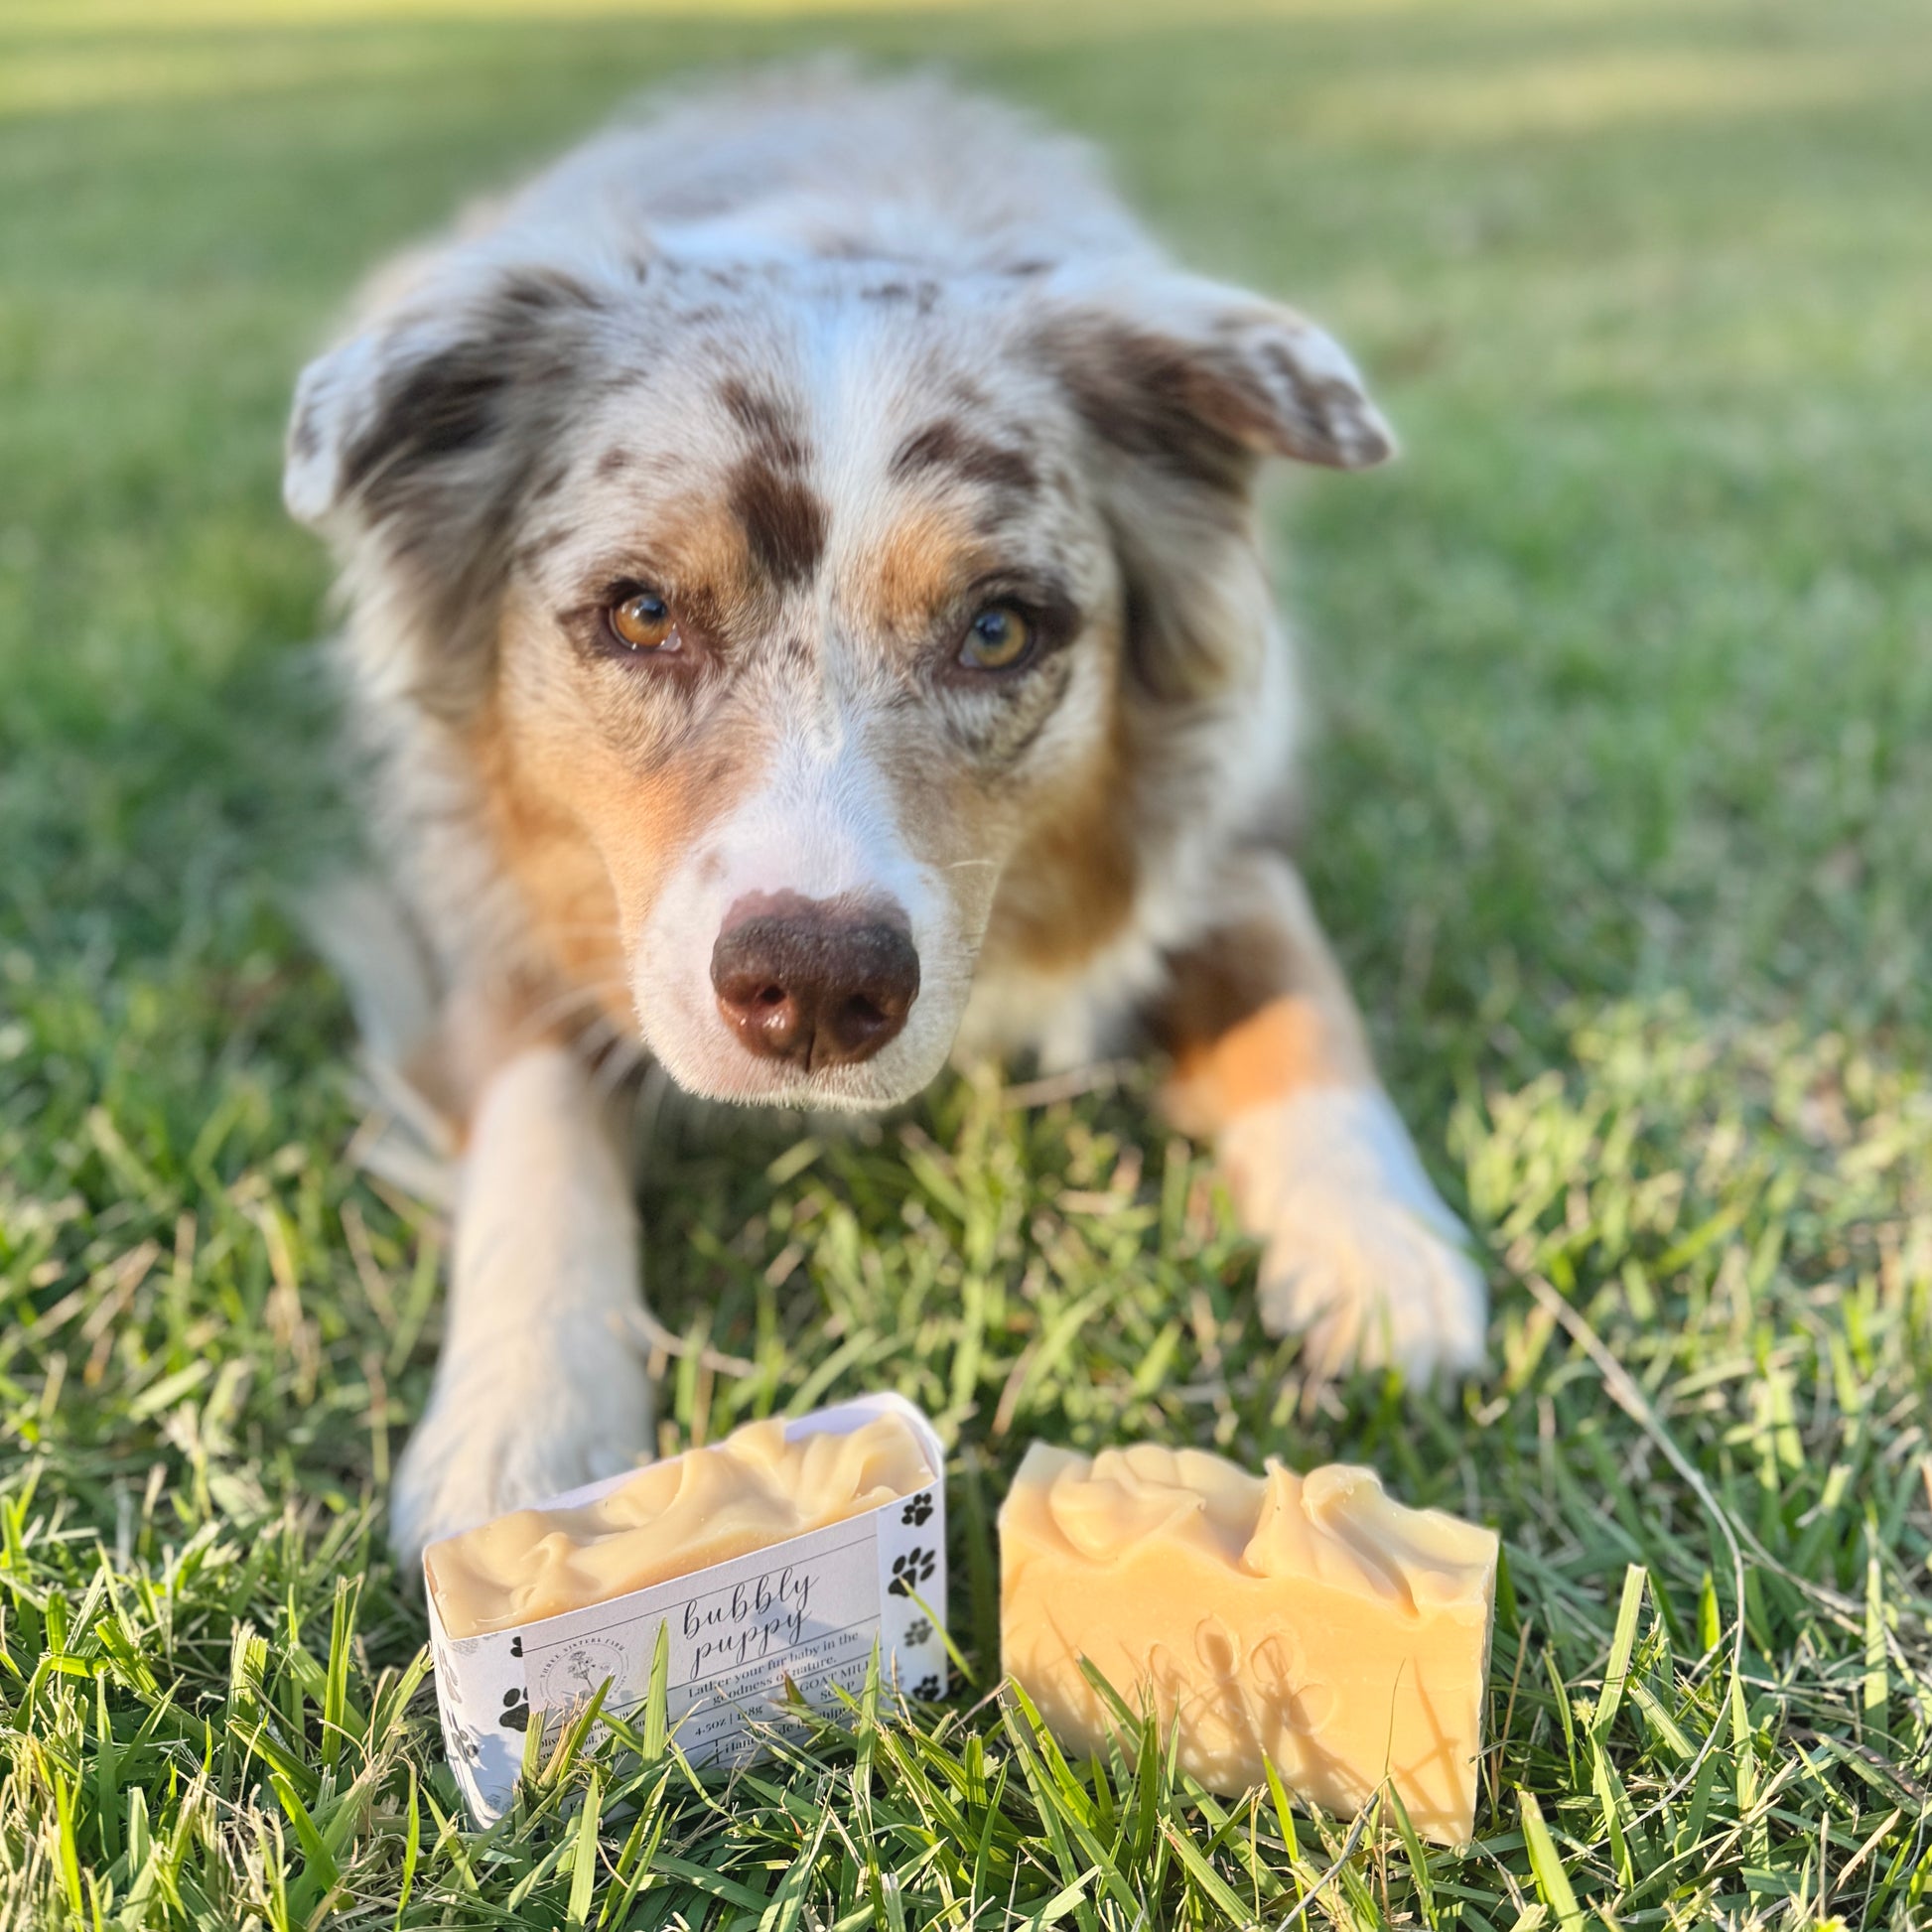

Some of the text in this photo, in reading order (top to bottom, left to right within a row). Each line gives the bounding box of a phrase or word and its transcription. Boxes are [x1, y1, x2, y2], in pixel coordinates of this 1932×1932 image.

[684, 1566, 820, 1640] bubbly
[690, 1609, 812, 1681] puppy
[735, 1664, 764, 1684] your
[767, 1656, 789, 1671] fur
[789, 1645, 820, 1662] baby
[823, 1639, 836, 1650] in
[839, 1631, 859, 1646] the
[792, 1656, 837, 1677] nature.
[737, 1706, 763, 1721] 18g
